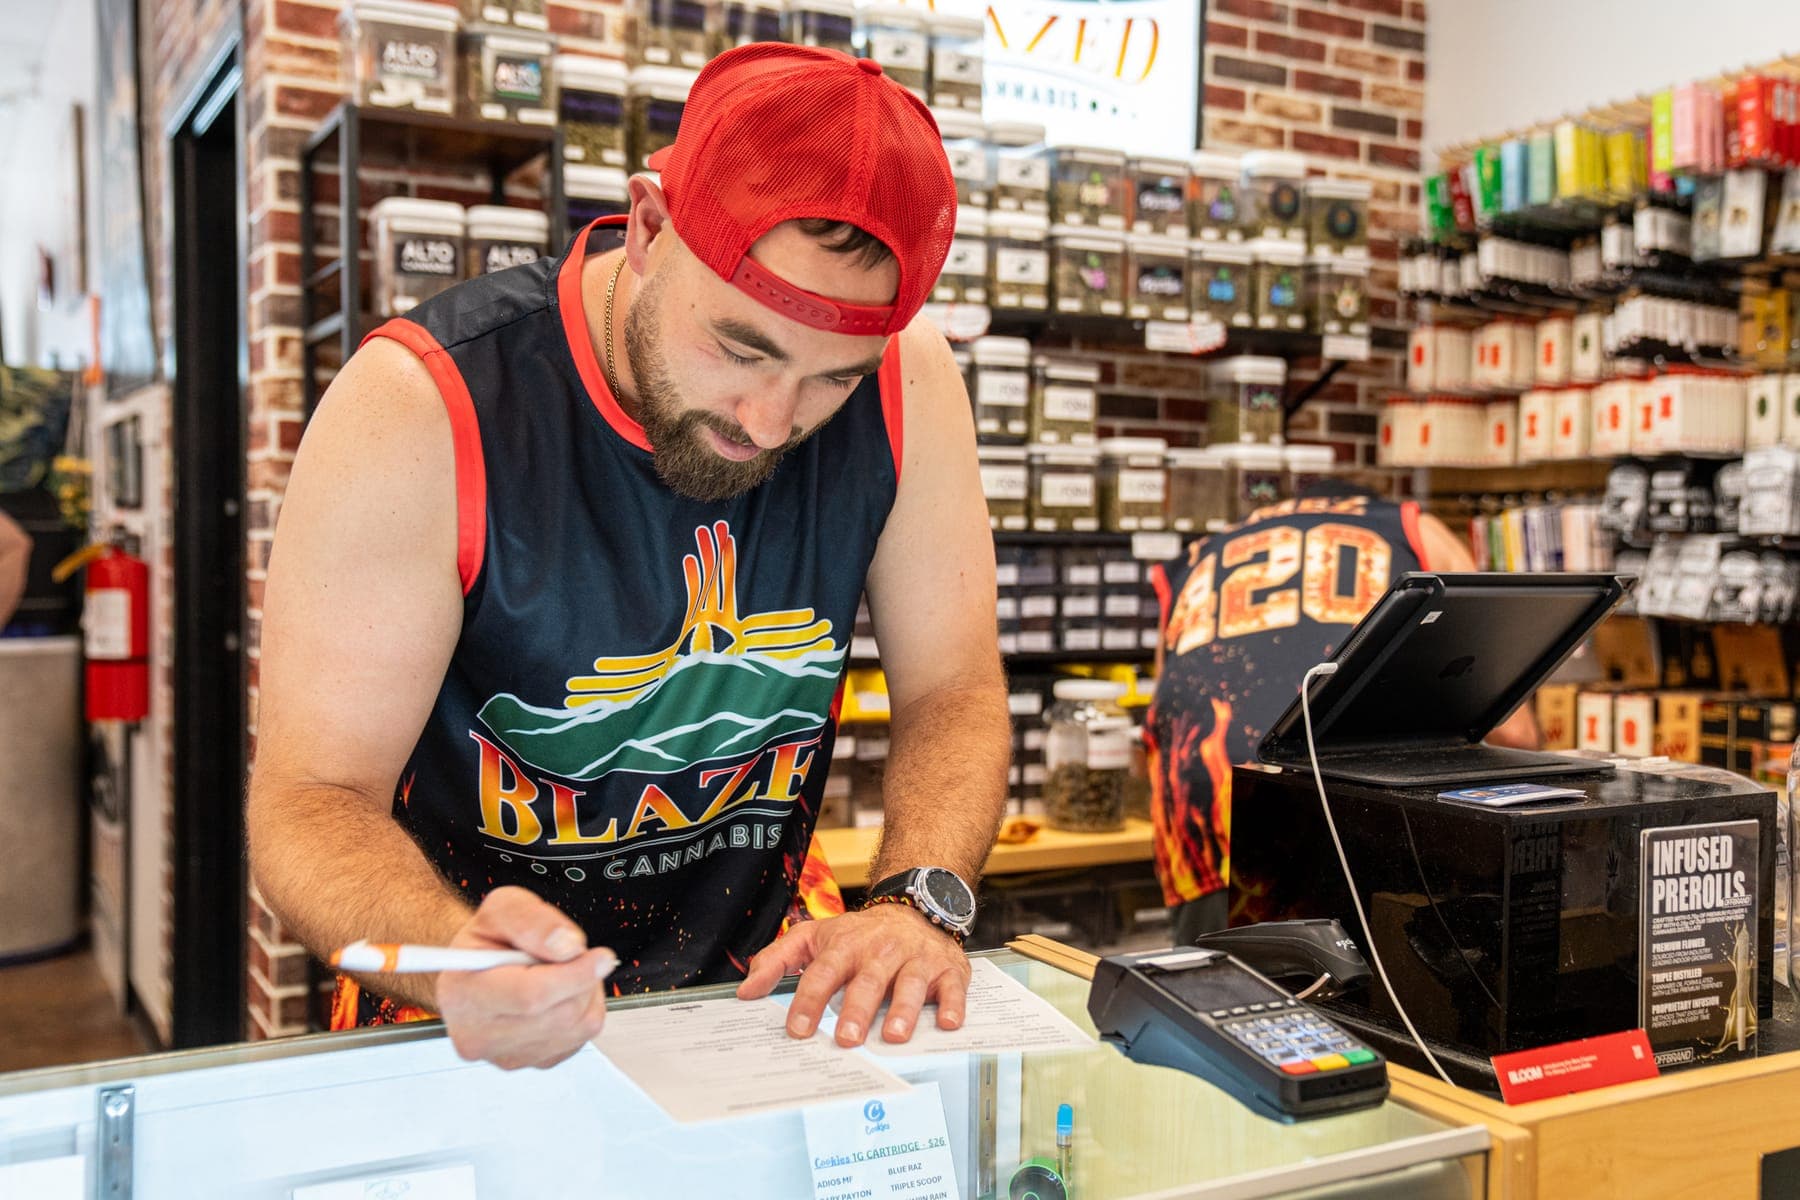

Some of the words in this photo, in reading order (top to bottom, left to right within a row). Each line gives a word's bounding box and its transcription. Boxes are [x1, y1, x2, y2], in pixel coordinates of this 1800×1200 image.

[383, 41, 438, 69] ALTO
[981, 80, 1078, 110] NNABIS
[402, 240, 455, 263] ALTO
[487, 245, 538, 266] ALTO
[1166, 522, 1392, 656] 420
[469, 728, 823, 845] BLAZE
[602, 822, 783, 881] CANNABIS
[1653, 835, 1733, 876] INFUSED
[1652, 870, 1746, 915] PREROLLS
[1681, 937, 1706, 950] FLOWER
[1508, 1064, 1545, 1086] BLOOM
[814, 1154, 851, 1169] Cookies
[852, 1150, 864, 1163] 1G
[866, 1140, 920, 1161] CARTRIDGE
[928, 1136, 946, 1149] $26
[888, 1165, 907, 1176] BLUE
[908, 1162, 923, 1172] RAZ
[817, 1177, 842, 1189] ADIOS
[842, 1189, 873, 1200] PAYTON
[890, 1180, 915, 1193] TRIPLE
[916, 1175, 943, 1187] SCOOP
[930, 1191, 948, 1200] RAIN
